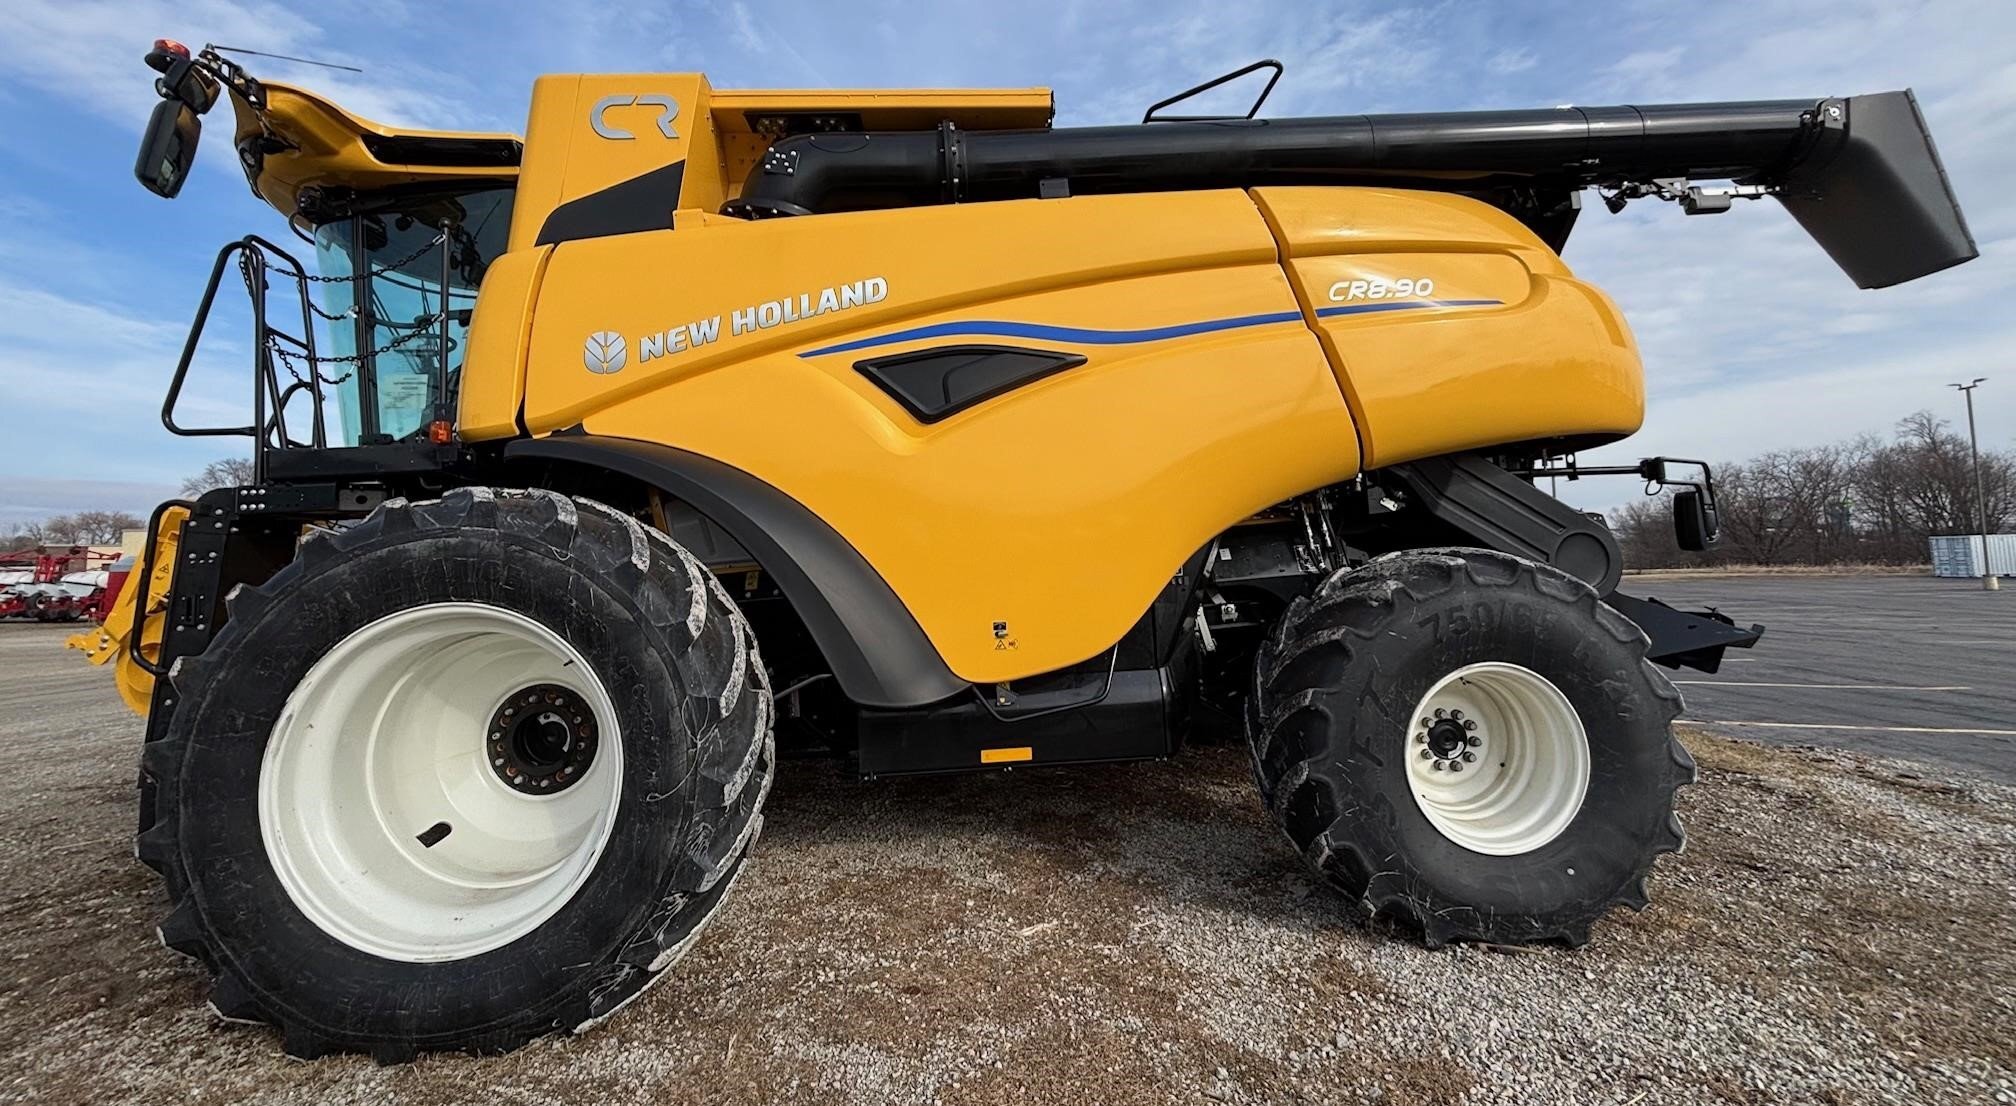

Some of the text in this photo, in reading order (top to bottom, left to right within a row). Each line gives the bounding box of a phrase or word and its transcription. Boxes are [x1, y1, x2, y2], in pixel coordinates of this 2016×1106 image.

[590, 94, 680, 140] CR
[1328, 278, 1434, 302] CR8.90
[639, 276, 888, 363] NEW HOLLAND
